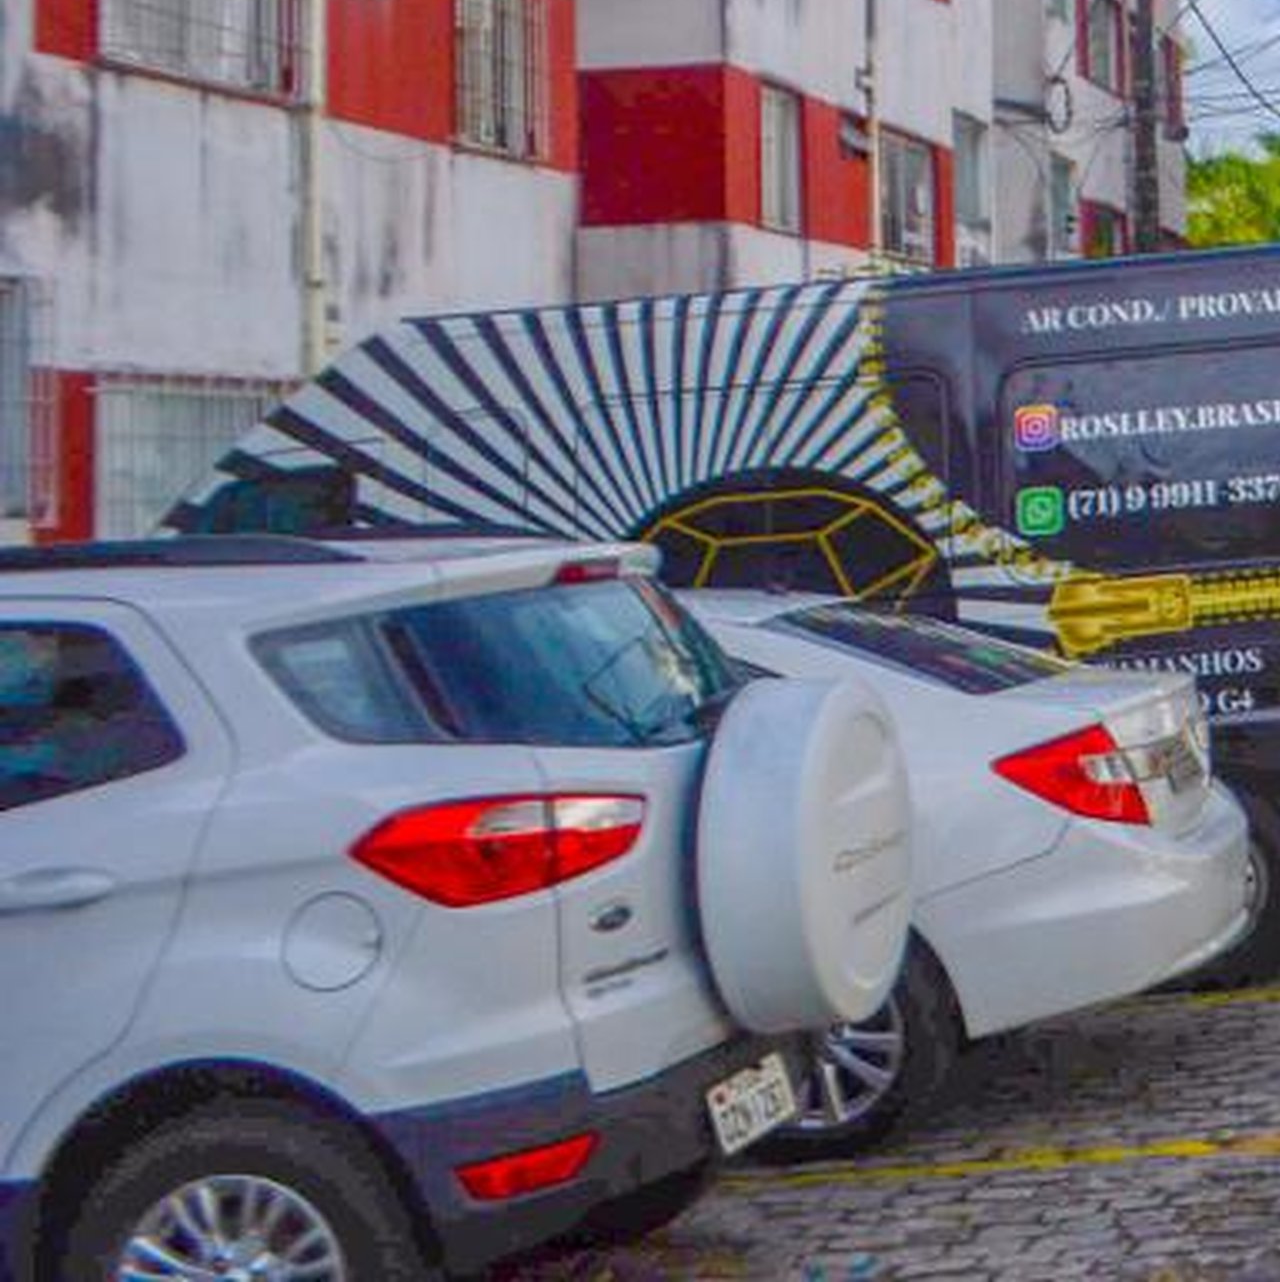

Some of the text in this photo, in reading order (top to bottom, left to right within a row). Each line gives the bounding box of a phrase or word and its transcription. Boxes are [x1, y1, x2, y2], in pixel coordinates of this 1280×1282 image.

[1021, 306, 1063, 333] AR
[1067, 486, 1120, 520] (71)
[1125, 484, 1147, 511] 9
[1217, 688, 1254, 715] G4
